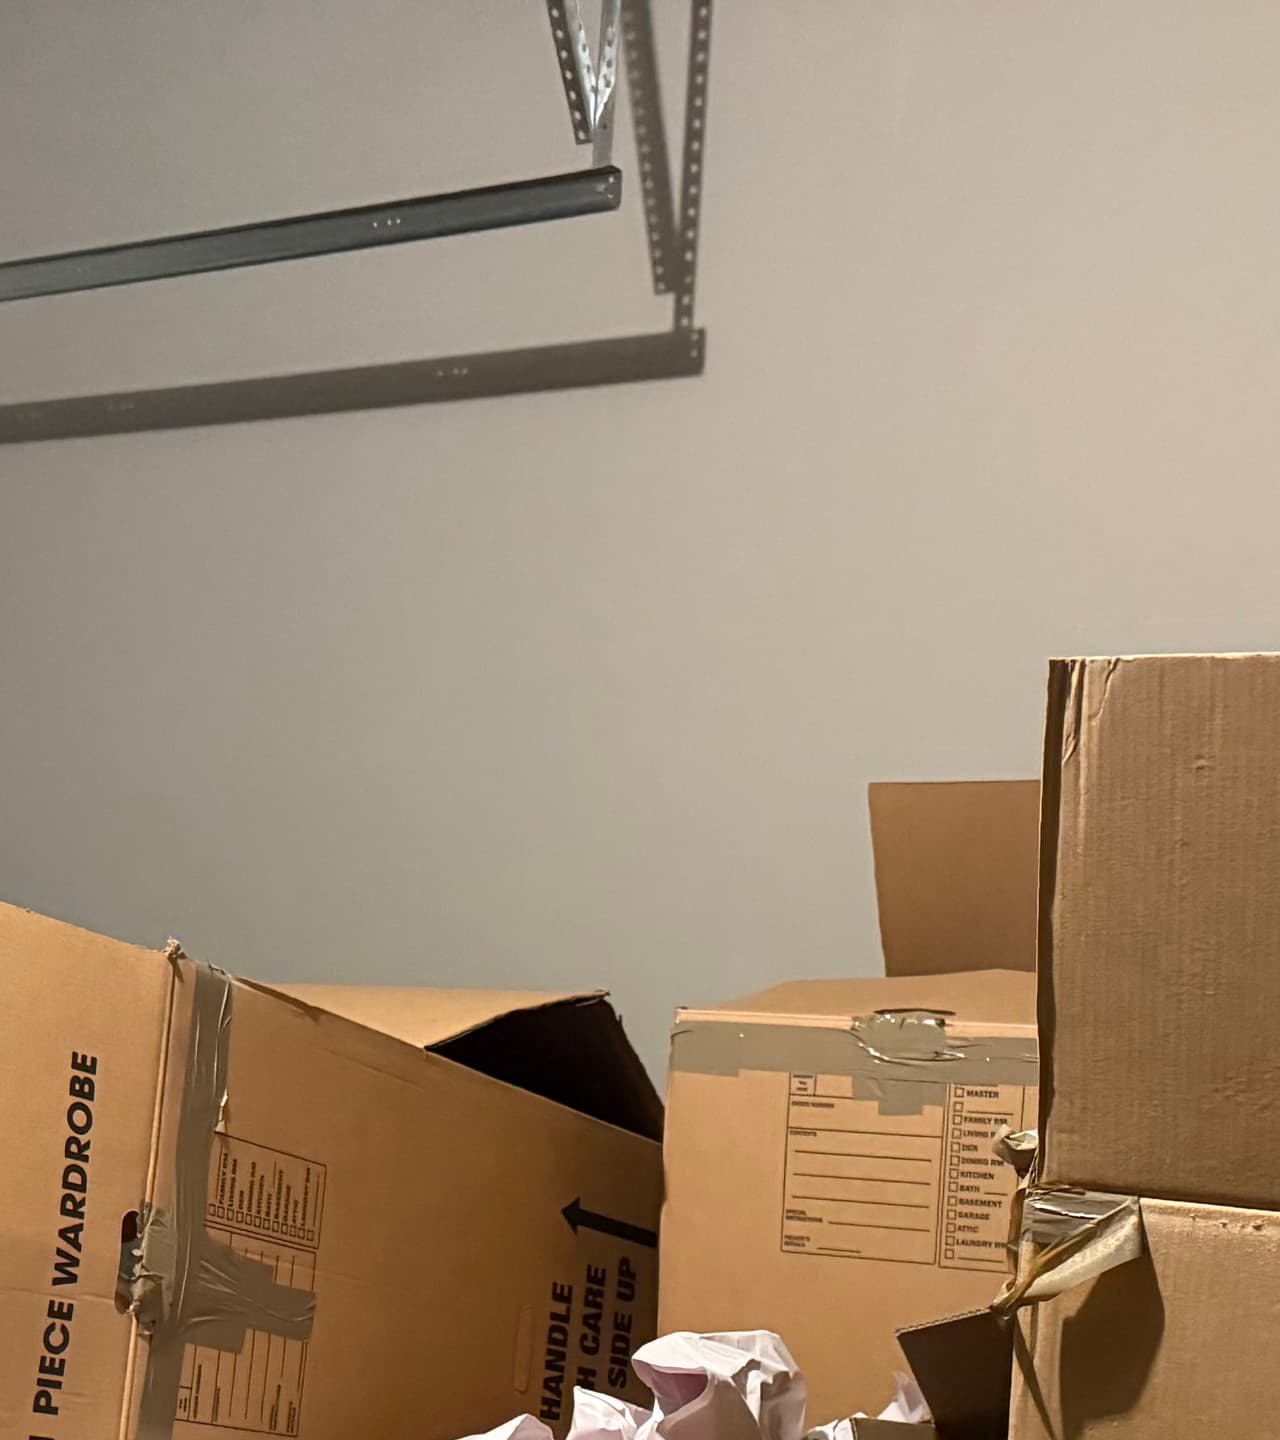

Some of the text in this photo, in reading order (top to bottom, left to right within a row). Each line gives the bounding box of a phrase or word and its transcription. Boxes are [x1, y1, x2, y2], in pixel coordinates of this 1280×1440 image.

[966, 1090, 999, 1099] MASTER
[51, 1051, 97, 1288] WARDROBE
[958, 1199, 1002, 1208] BASEMENT
[960, 1171, 994, 1180] KITCHEN
[32, 1300, 74, 1416] PIECE
[539, 1282, 573, 1422] HANDLE
[579, 1264, 607, 1356] CARE
[607, 1257, 637, 1389] SIDE UP
